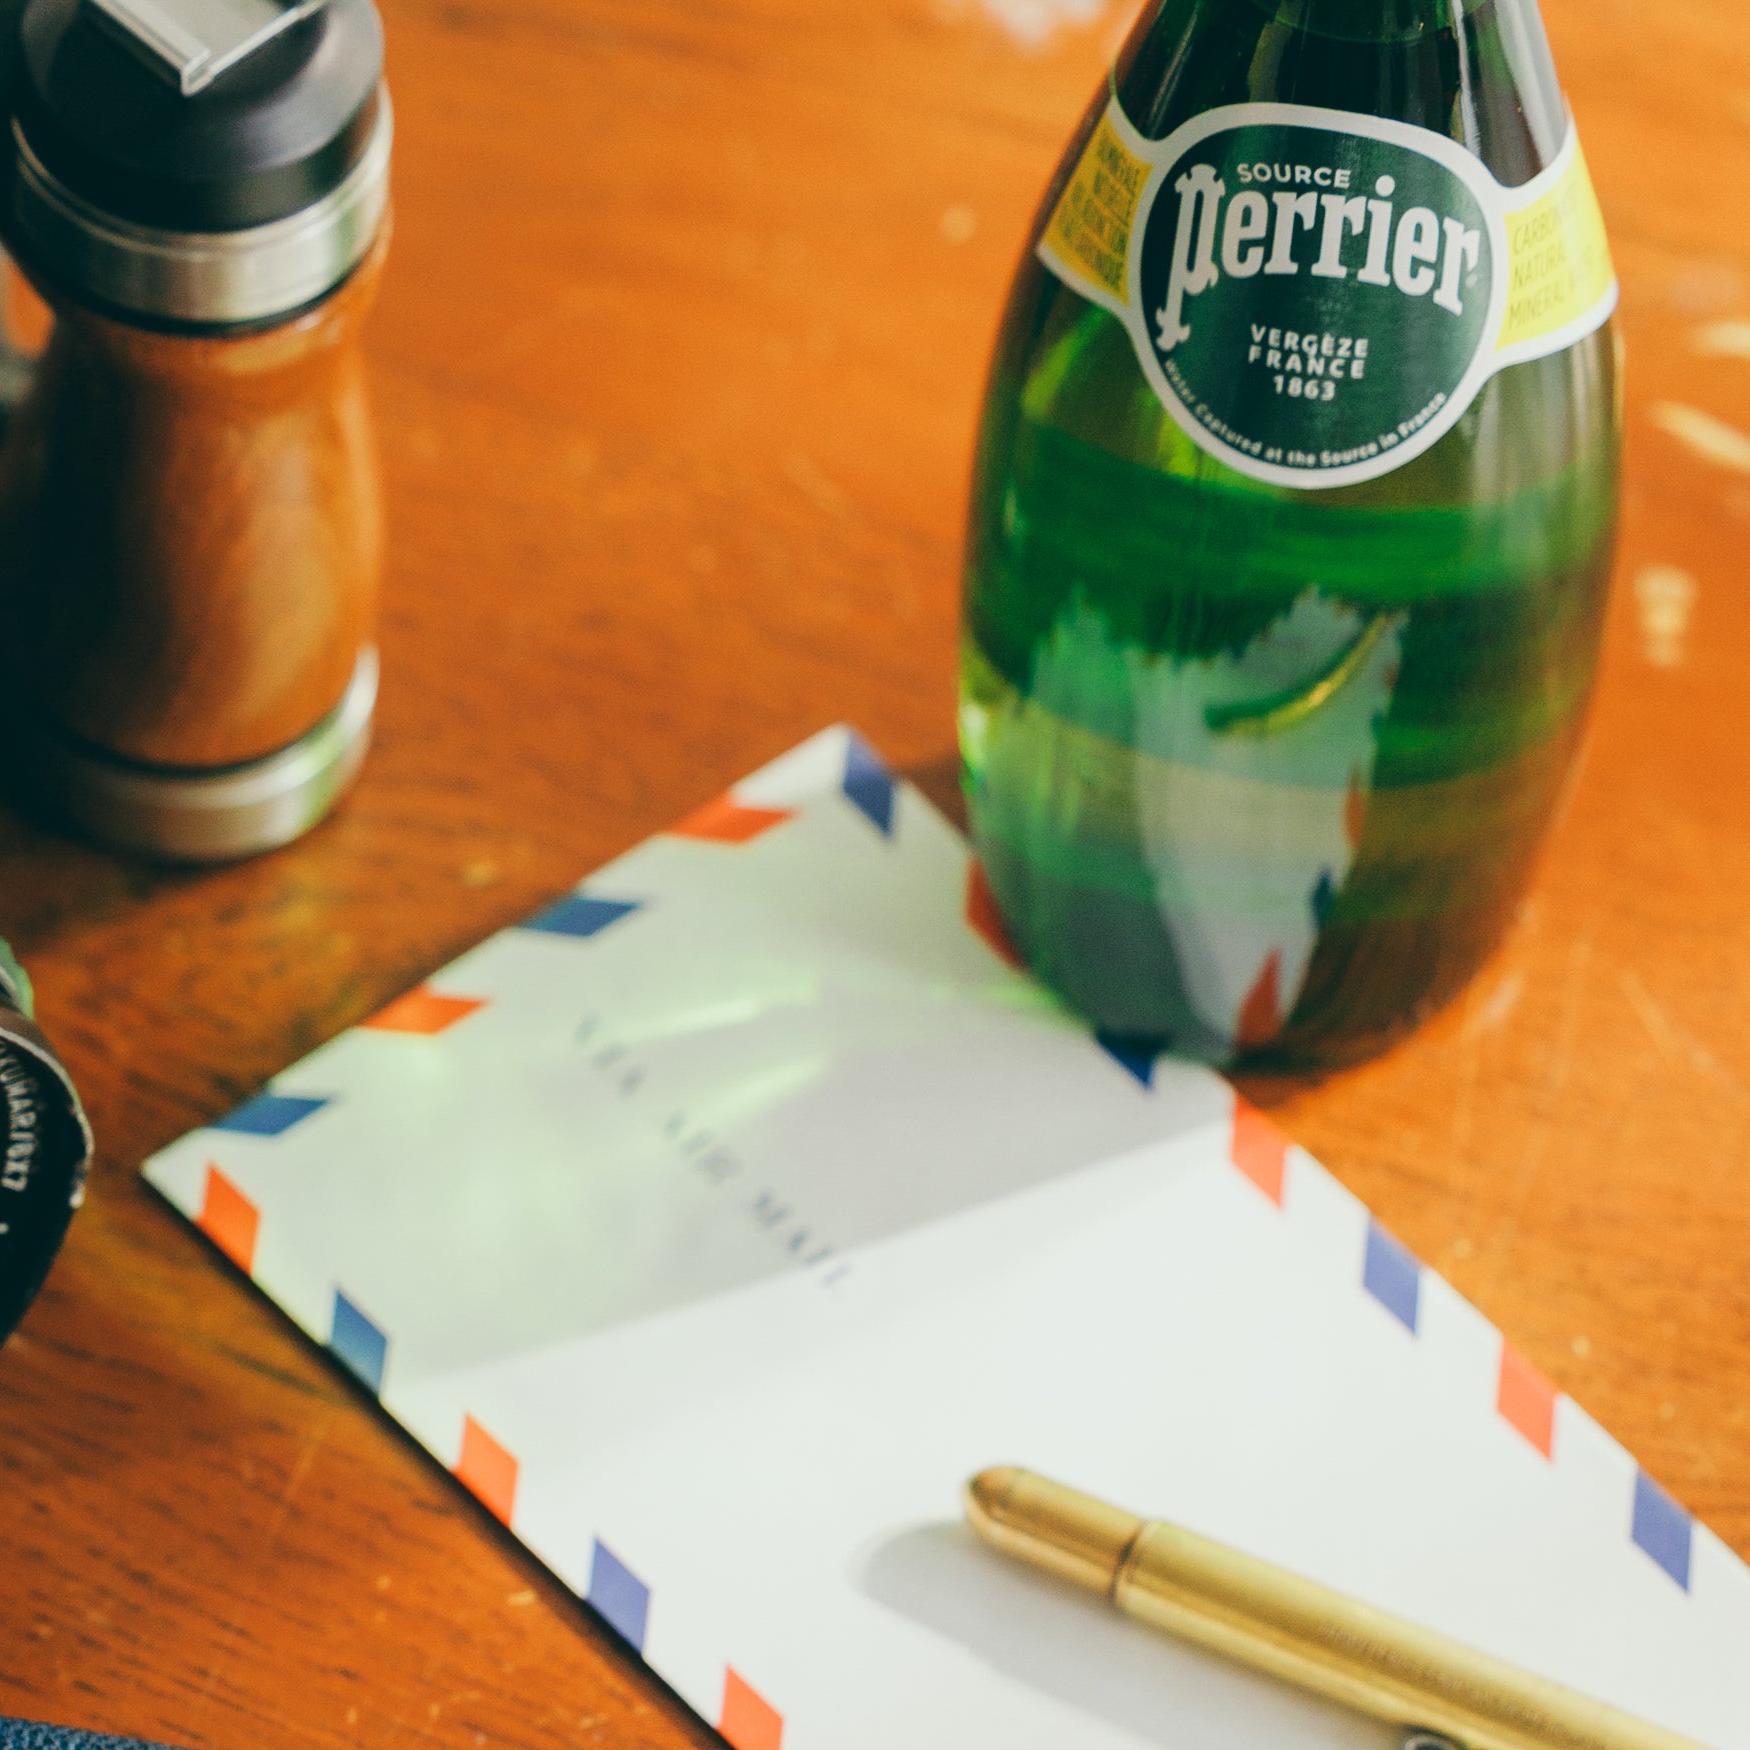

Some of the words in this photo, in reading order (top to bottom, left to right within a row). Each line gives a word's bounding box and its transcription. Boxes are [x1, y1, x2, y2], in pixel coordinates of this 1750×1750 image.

[1237, 162, 1352, 190] SOURCE
[1155, 162, 1482, 353] Perrier
[1248, 345, 1366, 379] FRANCE
[1273, 375, 1337, 401] 1863
[1195, 402, 1262, 456] Captured
[1264, 441, 1282, 461] at
[1286, 446, 1317, 467] the
[1319, 441, 1379, 467] Source
[1379, 432, 1400, 451] in
[1398, 391, 1447, 438] France
